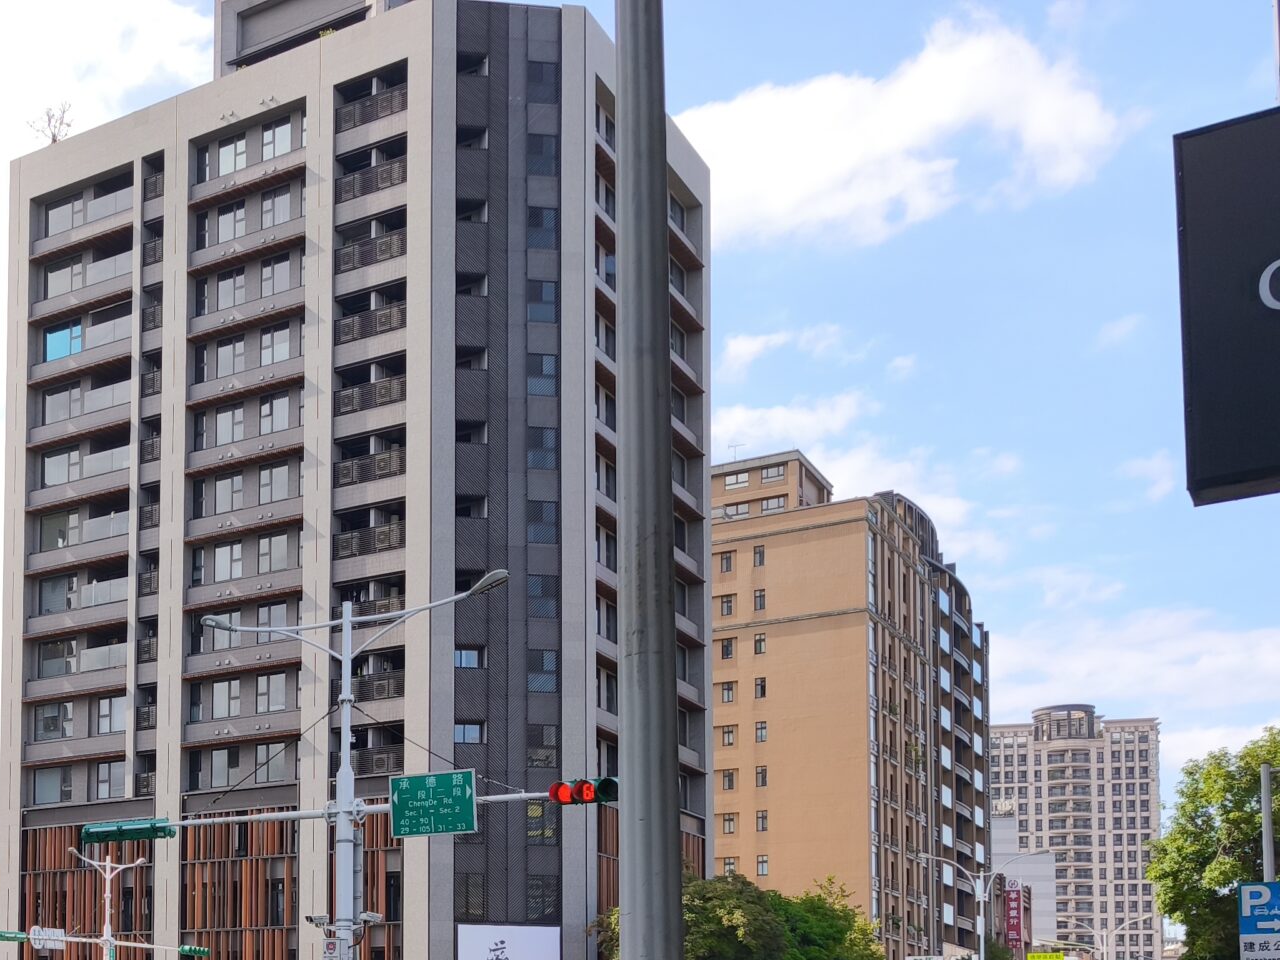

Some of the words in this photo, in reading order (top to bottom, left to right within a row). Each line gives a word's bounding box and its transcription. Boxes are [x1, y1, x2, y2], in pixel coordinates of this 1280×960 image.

[399, 774, 463, 790] 承德路
[1241, 885, 1271, 917] P
